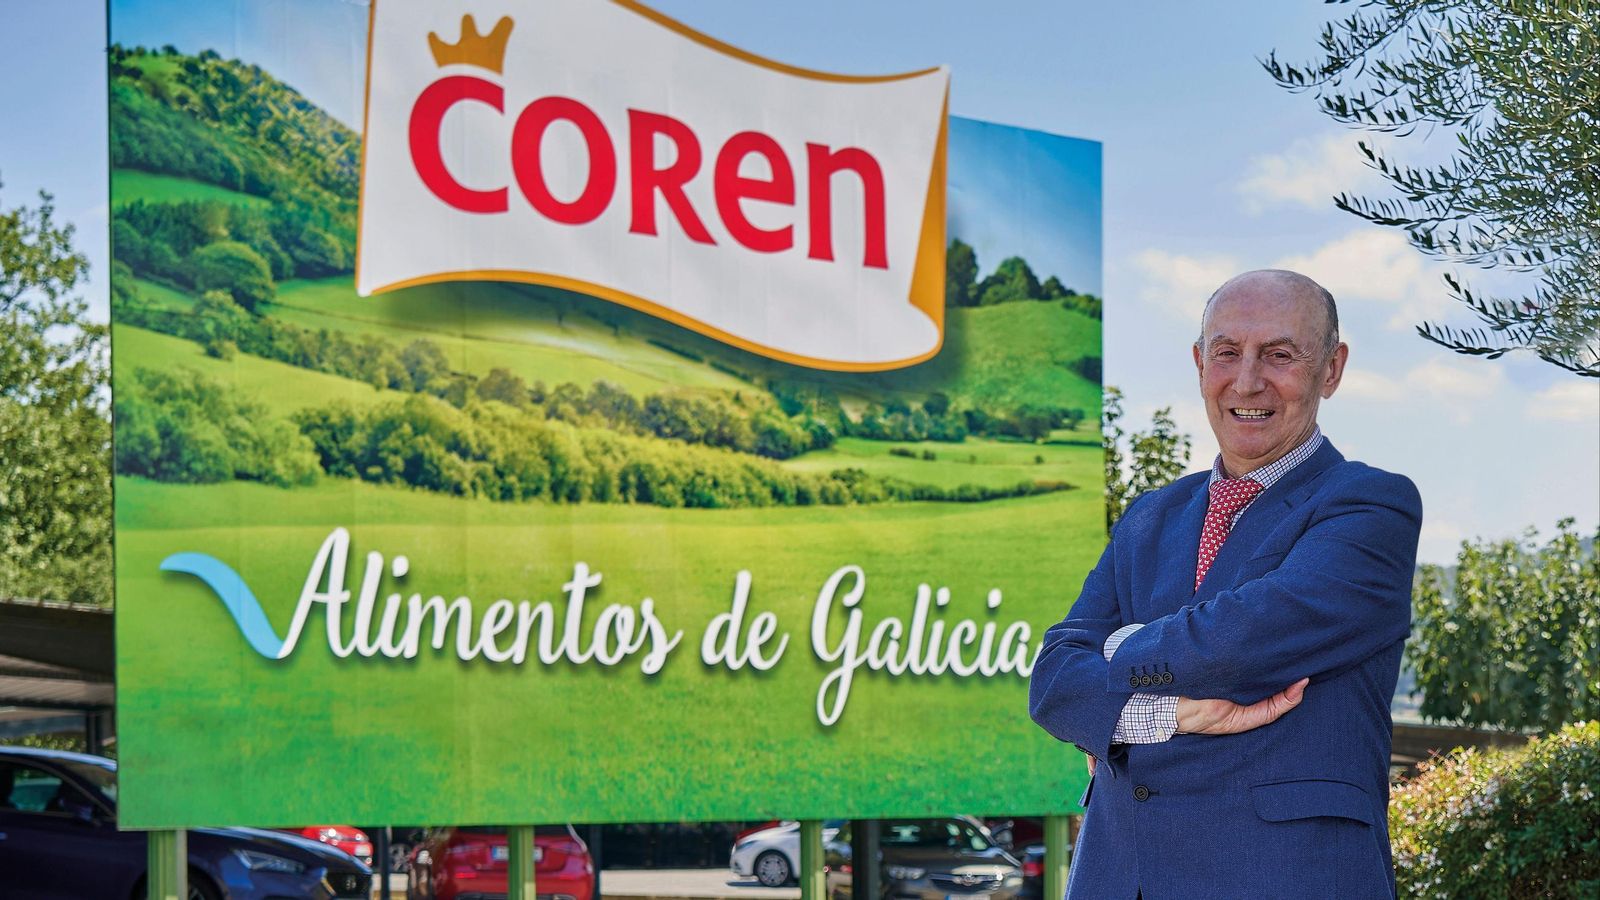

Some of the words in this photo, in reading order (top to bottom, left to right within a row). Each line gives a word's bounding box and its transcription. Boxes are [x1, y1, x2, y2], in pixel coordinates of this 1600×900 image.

[277, 526, 684, 675] Alimentos
[701, 569, 790, 671] de
[810, 564, 1044, 727] Galicia
